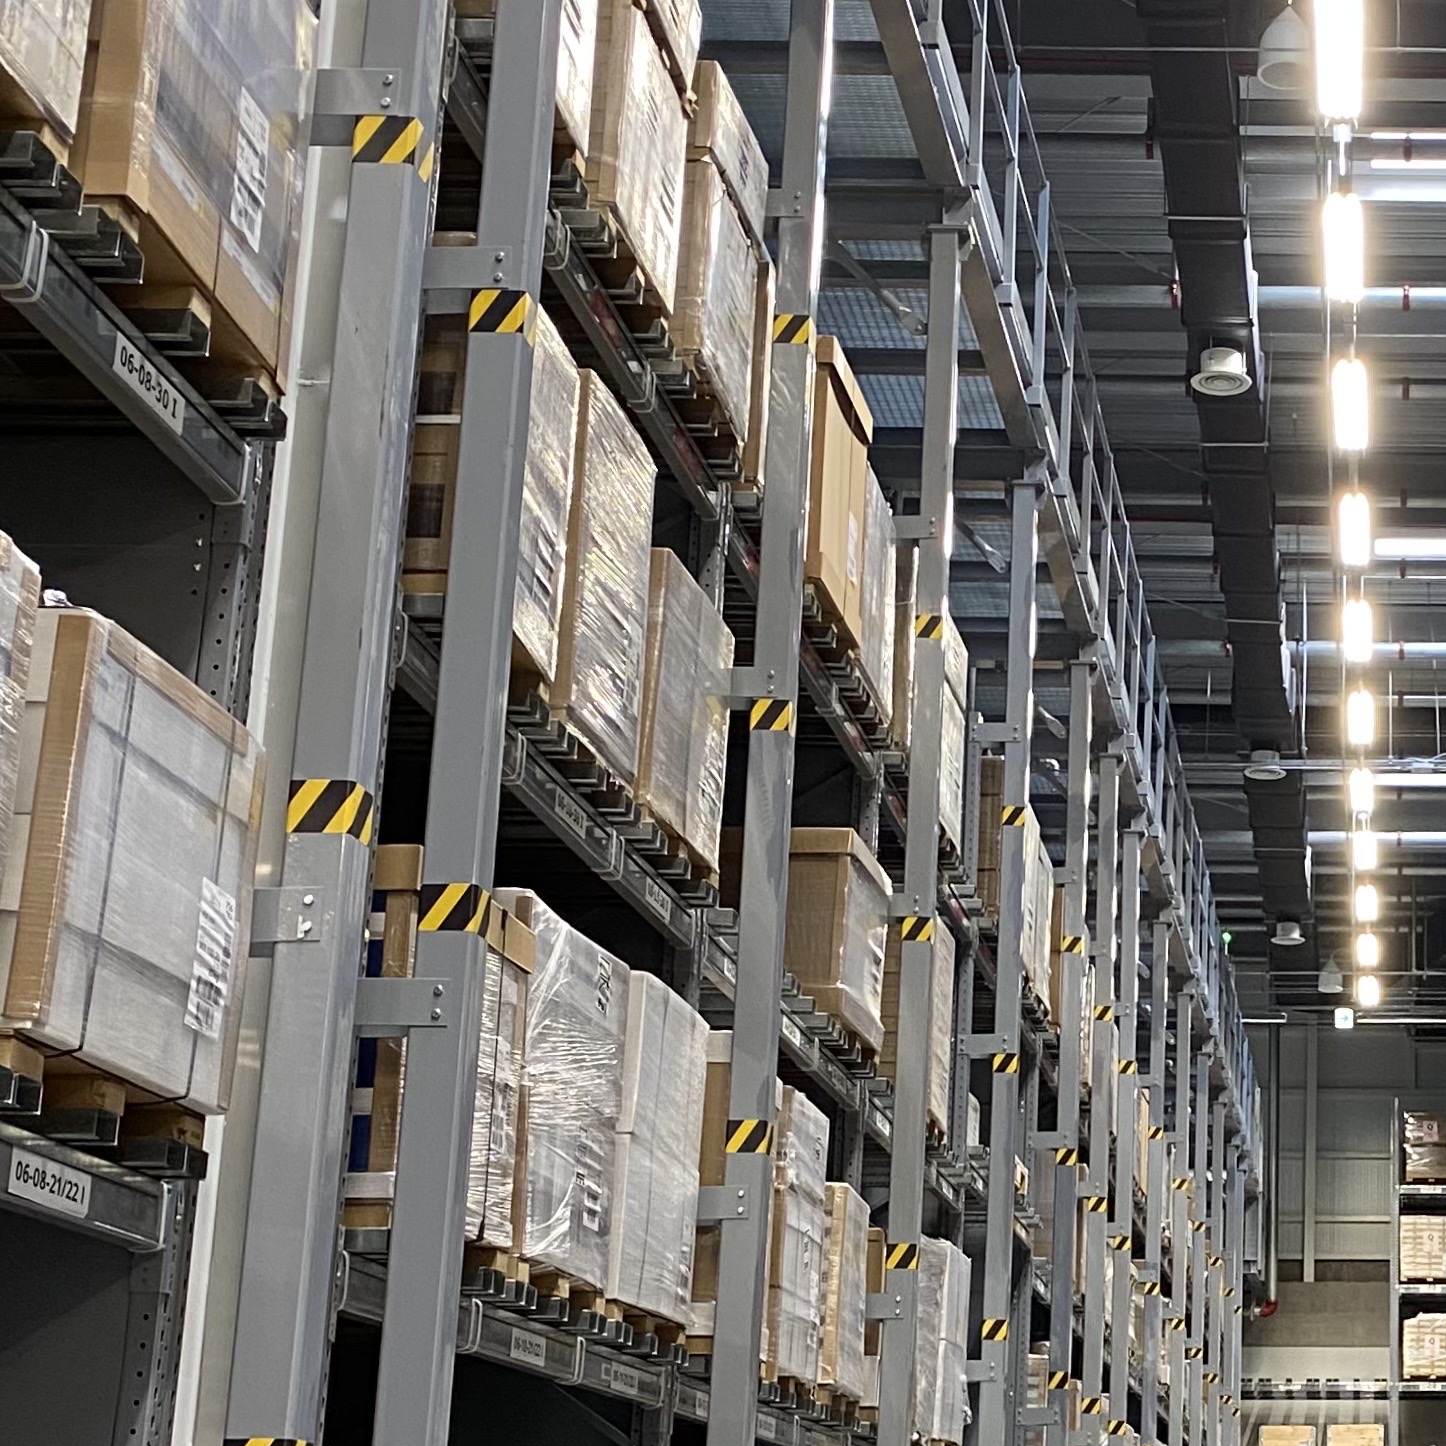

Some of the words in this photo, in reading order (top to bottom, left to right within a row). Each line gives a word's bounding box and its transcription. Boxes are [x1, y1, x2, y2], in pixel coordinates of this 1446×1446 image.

[120, 345, 169, 409] 06-08-30
[171, 398, 178, 419] I
[15, 1160, 78, 1203] 06-08-21/22
